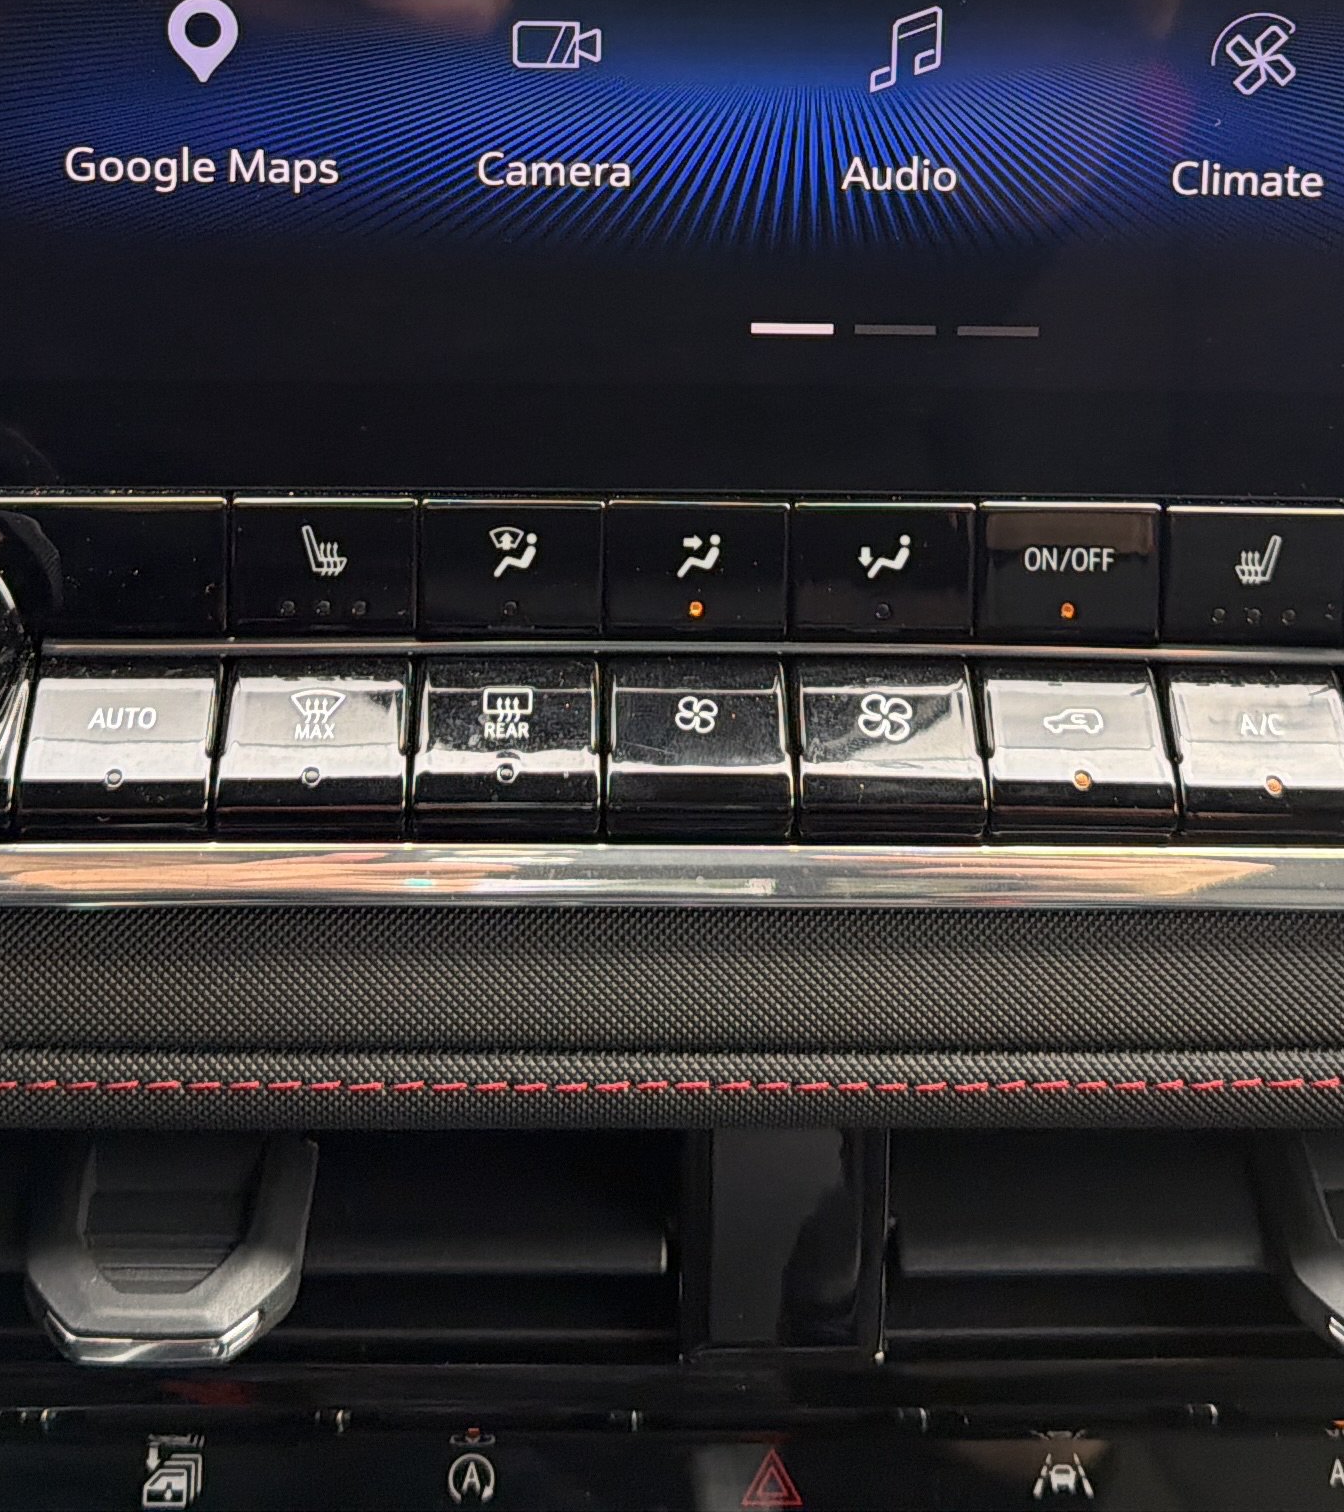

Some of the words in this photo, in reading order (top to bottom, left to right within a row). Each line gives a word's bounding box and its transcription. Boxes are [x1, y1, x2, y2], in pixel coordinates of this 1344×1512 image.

[65, 146, 216, 193] Google
[229, 146, 340, 194] Maps
[476, 149, 633, 188] Camera
[841, 155, 959, 192] Audio
[1172, 159, 1324, 198] Climate
[1024, 546, 1115, 572] ON/OFF
[87, 706, 157, 730] AUTO
[294, 720, 336, 740] MAX
[484, 721, 529, 739] REAR
[1240, 713, 1285, 736] A/C
